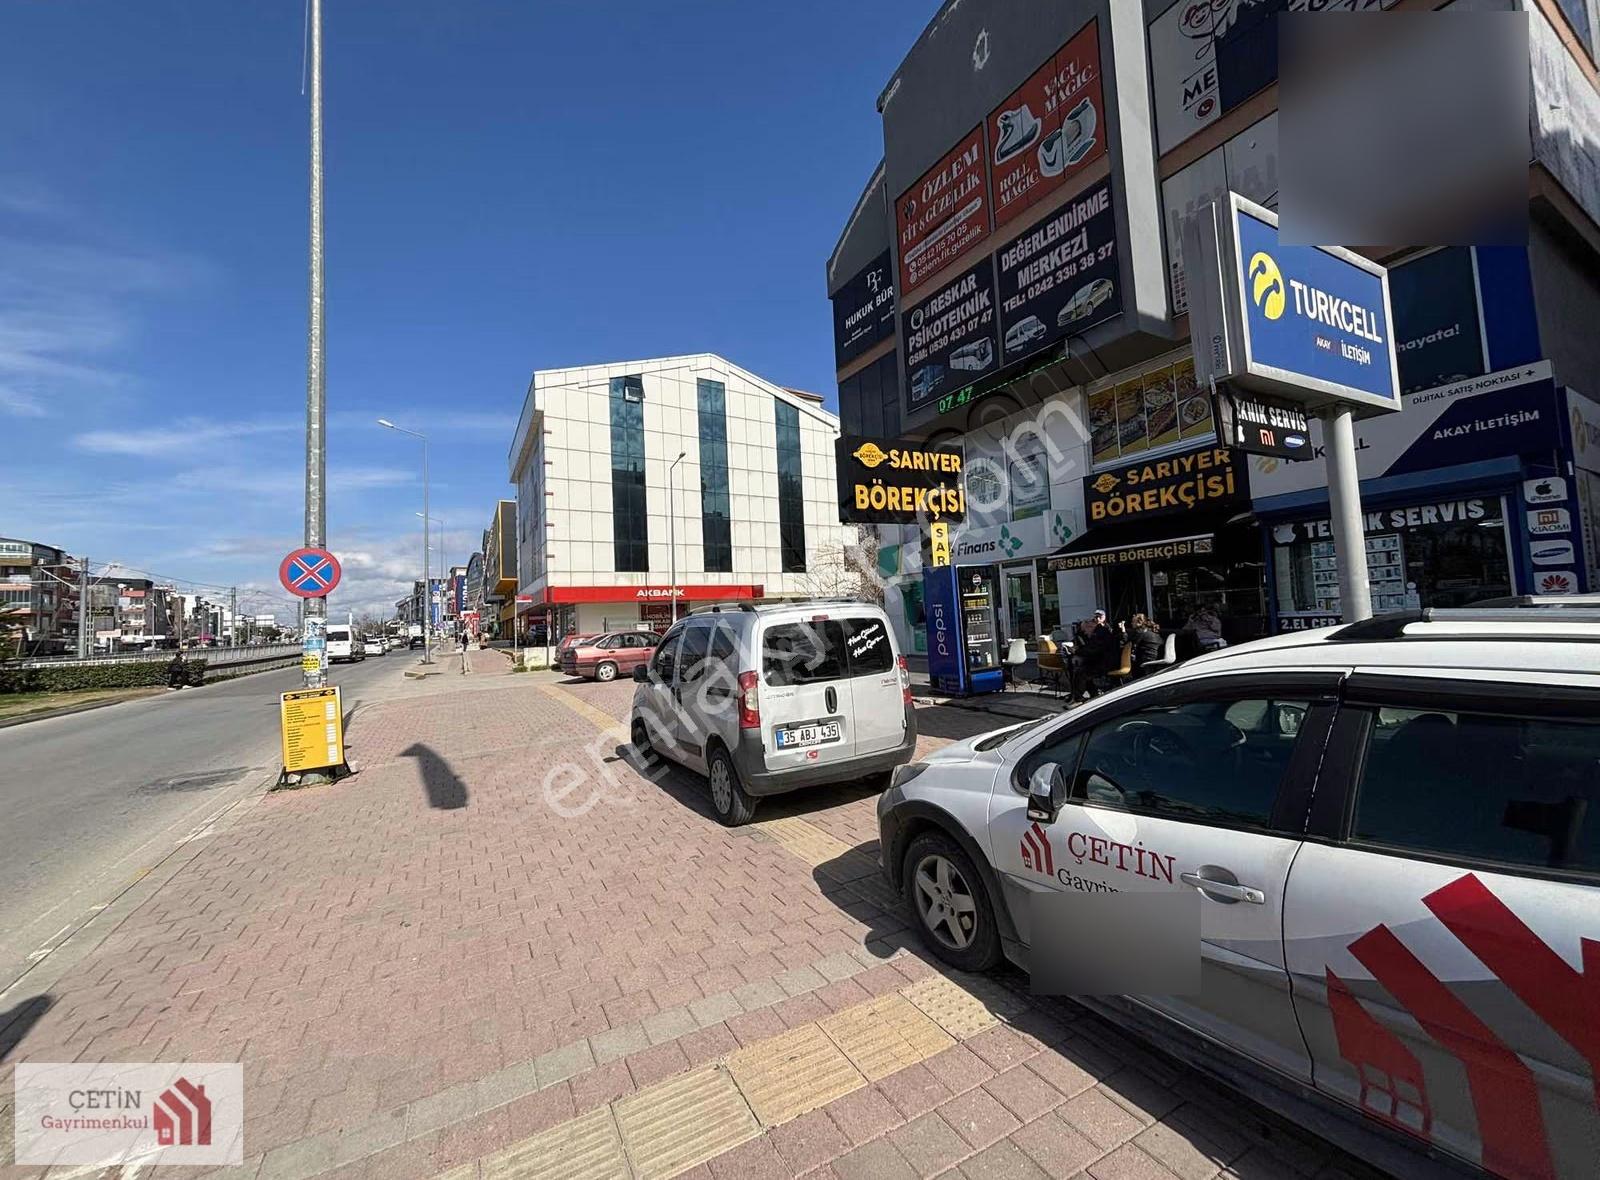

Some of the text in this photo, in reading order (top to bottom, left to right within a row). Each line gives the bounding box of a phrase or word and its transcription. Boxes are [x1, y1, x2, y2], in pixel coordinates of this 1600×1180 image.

[1044, 57, 1080, 97] VACU
[1045, 64, 1093, 113] MAGIC
[921, 143, 979, 203] ÖZLEM
[1000, 163, 1031, 192] ROLL
[1000, 168, 1039, 206] MAGIC
[925, 170, 981, 224] GÜZELLİK
[1001, 187, 1110, 272] DEĞERLENDİRME
[1002, 293, 1026, 313] TEL:
[1027, 275, 1054, 300] 0242
[1079, 252, 1096, 271] 38
[1097, 240, 1114, 261] 37
[1017, 226, 1089, 290] MERKEZİ
[845, 300, 875, 330] HUKUK
[930, 273, 978, 318] RESKAR
[1290, 279, 1383, 344] TURKCELL
[908, 288, 992, 353] PSİKOTEKNİK
[908, 349, 928, 367] GSM:
[928, 335, 949, 355] 0530
[967, 316, 980, 333] 07
[980, 308, 993, 325] 47
[1316, 336, 1371, 366] AKAY İLETİŞİM
[957, 385, 974, 402] 47
[1412, 371, 1521, 405] DİJİTAL SATIŞ NOKTASI
[1268, 405, 1308, 432] SERVİS
[1432, 409, 1540, 440] AKAY İLETİŞİM
[889, 449, 962, 473] SARIYER
[1127, 448, 1231, 486] SARIYER
[854, 478, 966, 520] BÖREKÇİSİ
[1090, 466, 1236, 521] BÖREKÇİSİ
[1390, 499, 1485, 529] SERVIS
[957, 540, 996, 557] Finans
[1066, 541, 1193, 569] SARIYER BÖREKÇİSİ
[932, 603, 949, 656] pepsi
[1281, 618, 1309, 631] 2.EL
[784, 731, 796, 745] 35
[800, 729, 817, 743] ABJ
[820, 724, 837, 739] 435
[1067, 831, 1177, 885] ÇETİN
